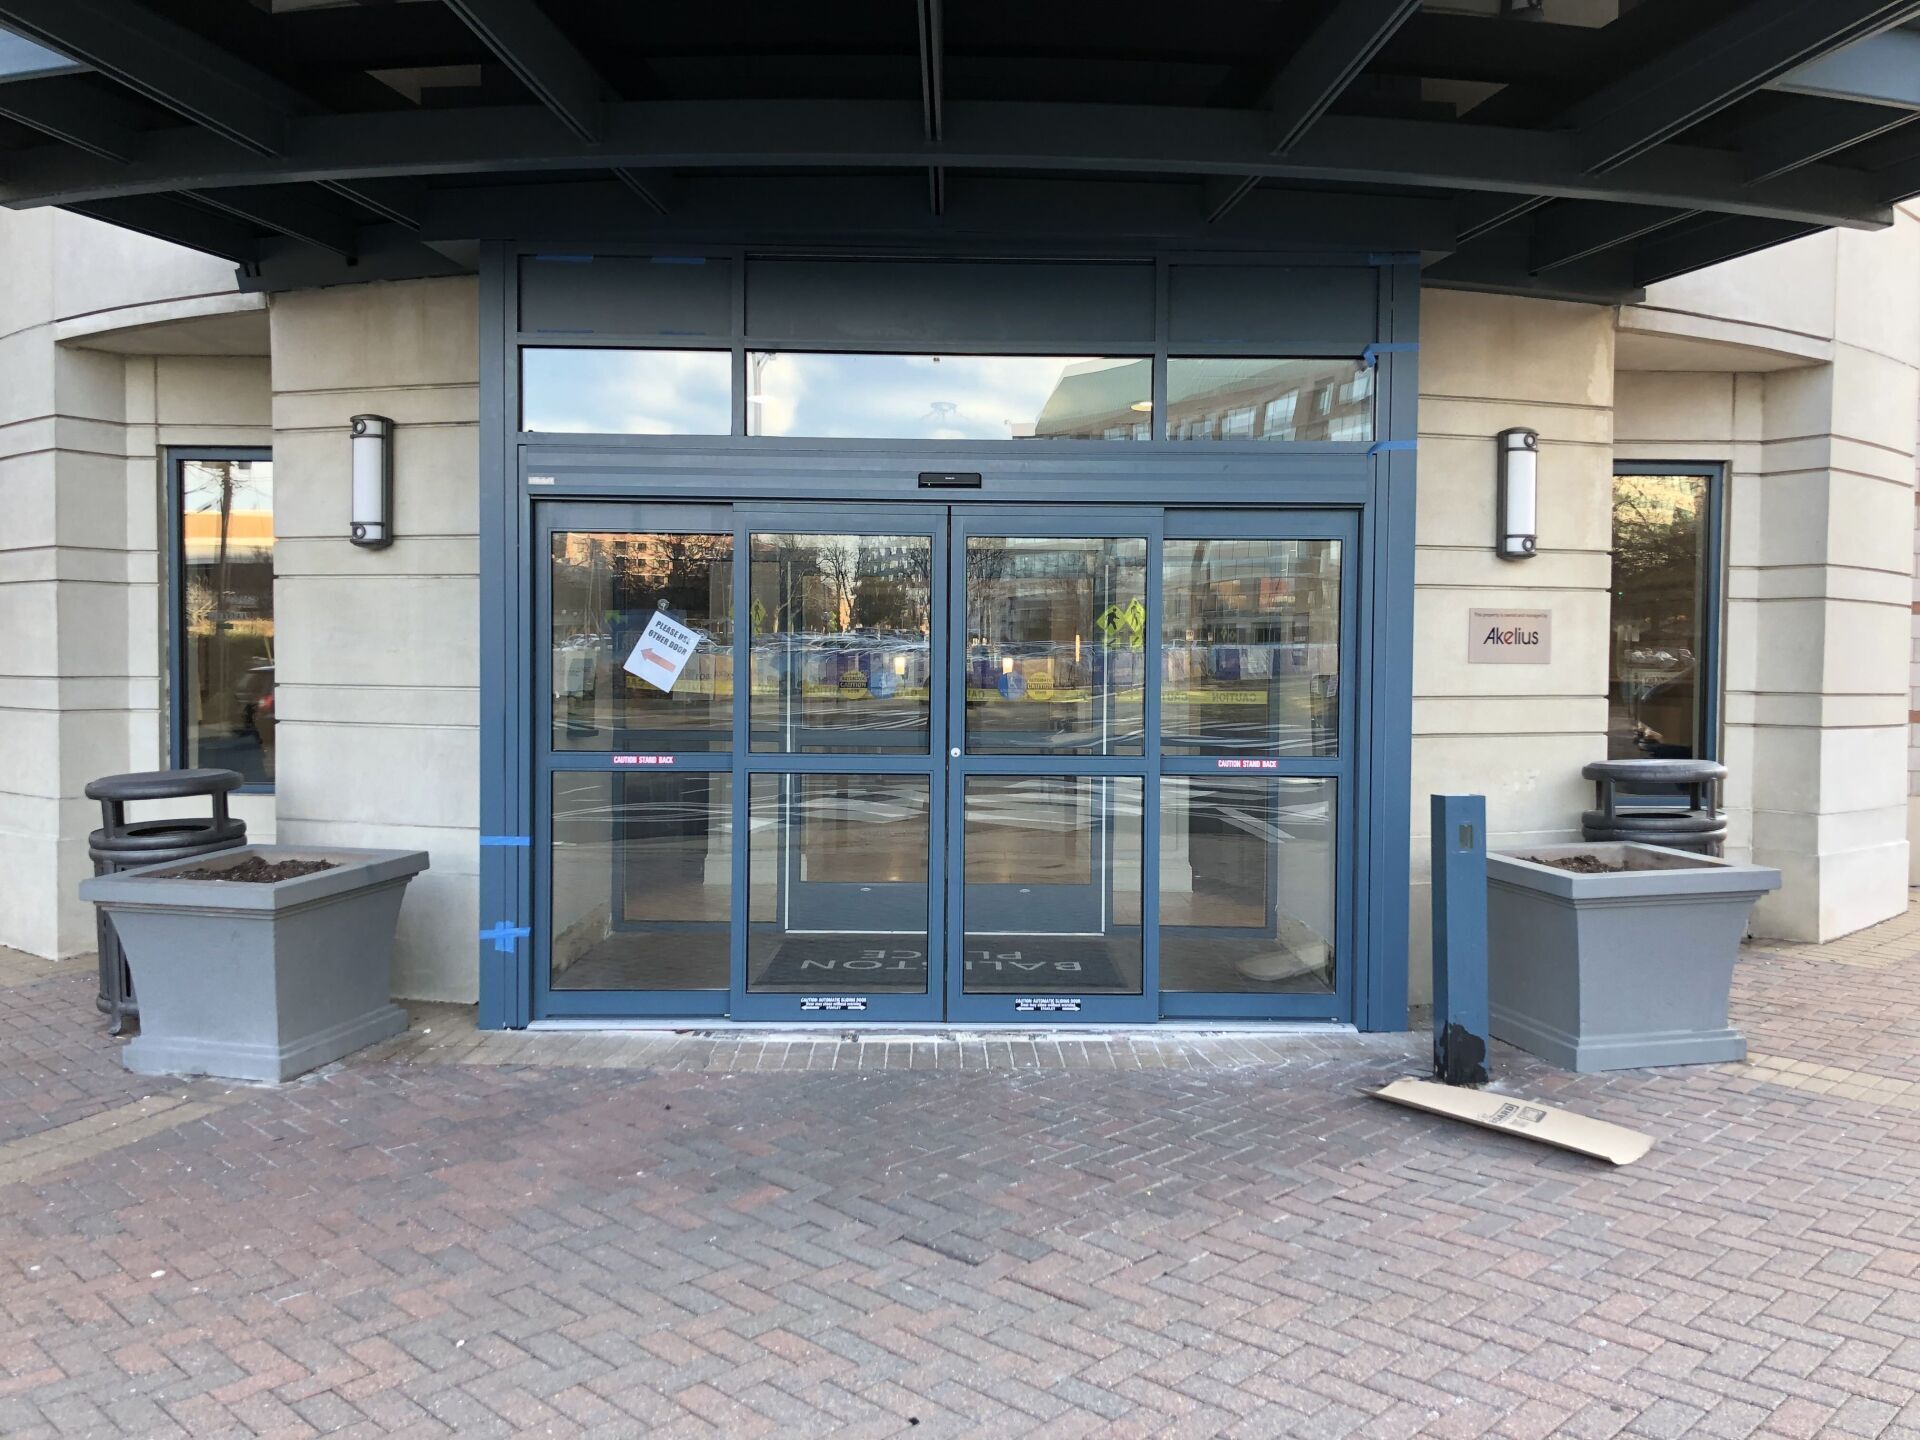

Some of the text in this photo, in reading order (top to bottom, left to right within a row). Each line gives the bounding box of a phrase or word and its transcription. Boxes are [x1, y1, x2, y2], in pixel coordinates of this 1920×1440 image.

[655, 620, 677, 638] PLEASE
[1483, 627, 1539, 645] Akelius
[648, 629, 688, 656] OTHER DOOR
[613, 755, 674, 764] CAUTION STAND BACK
[1217, 759, 1277, 768] CAUTION STAND BACK
